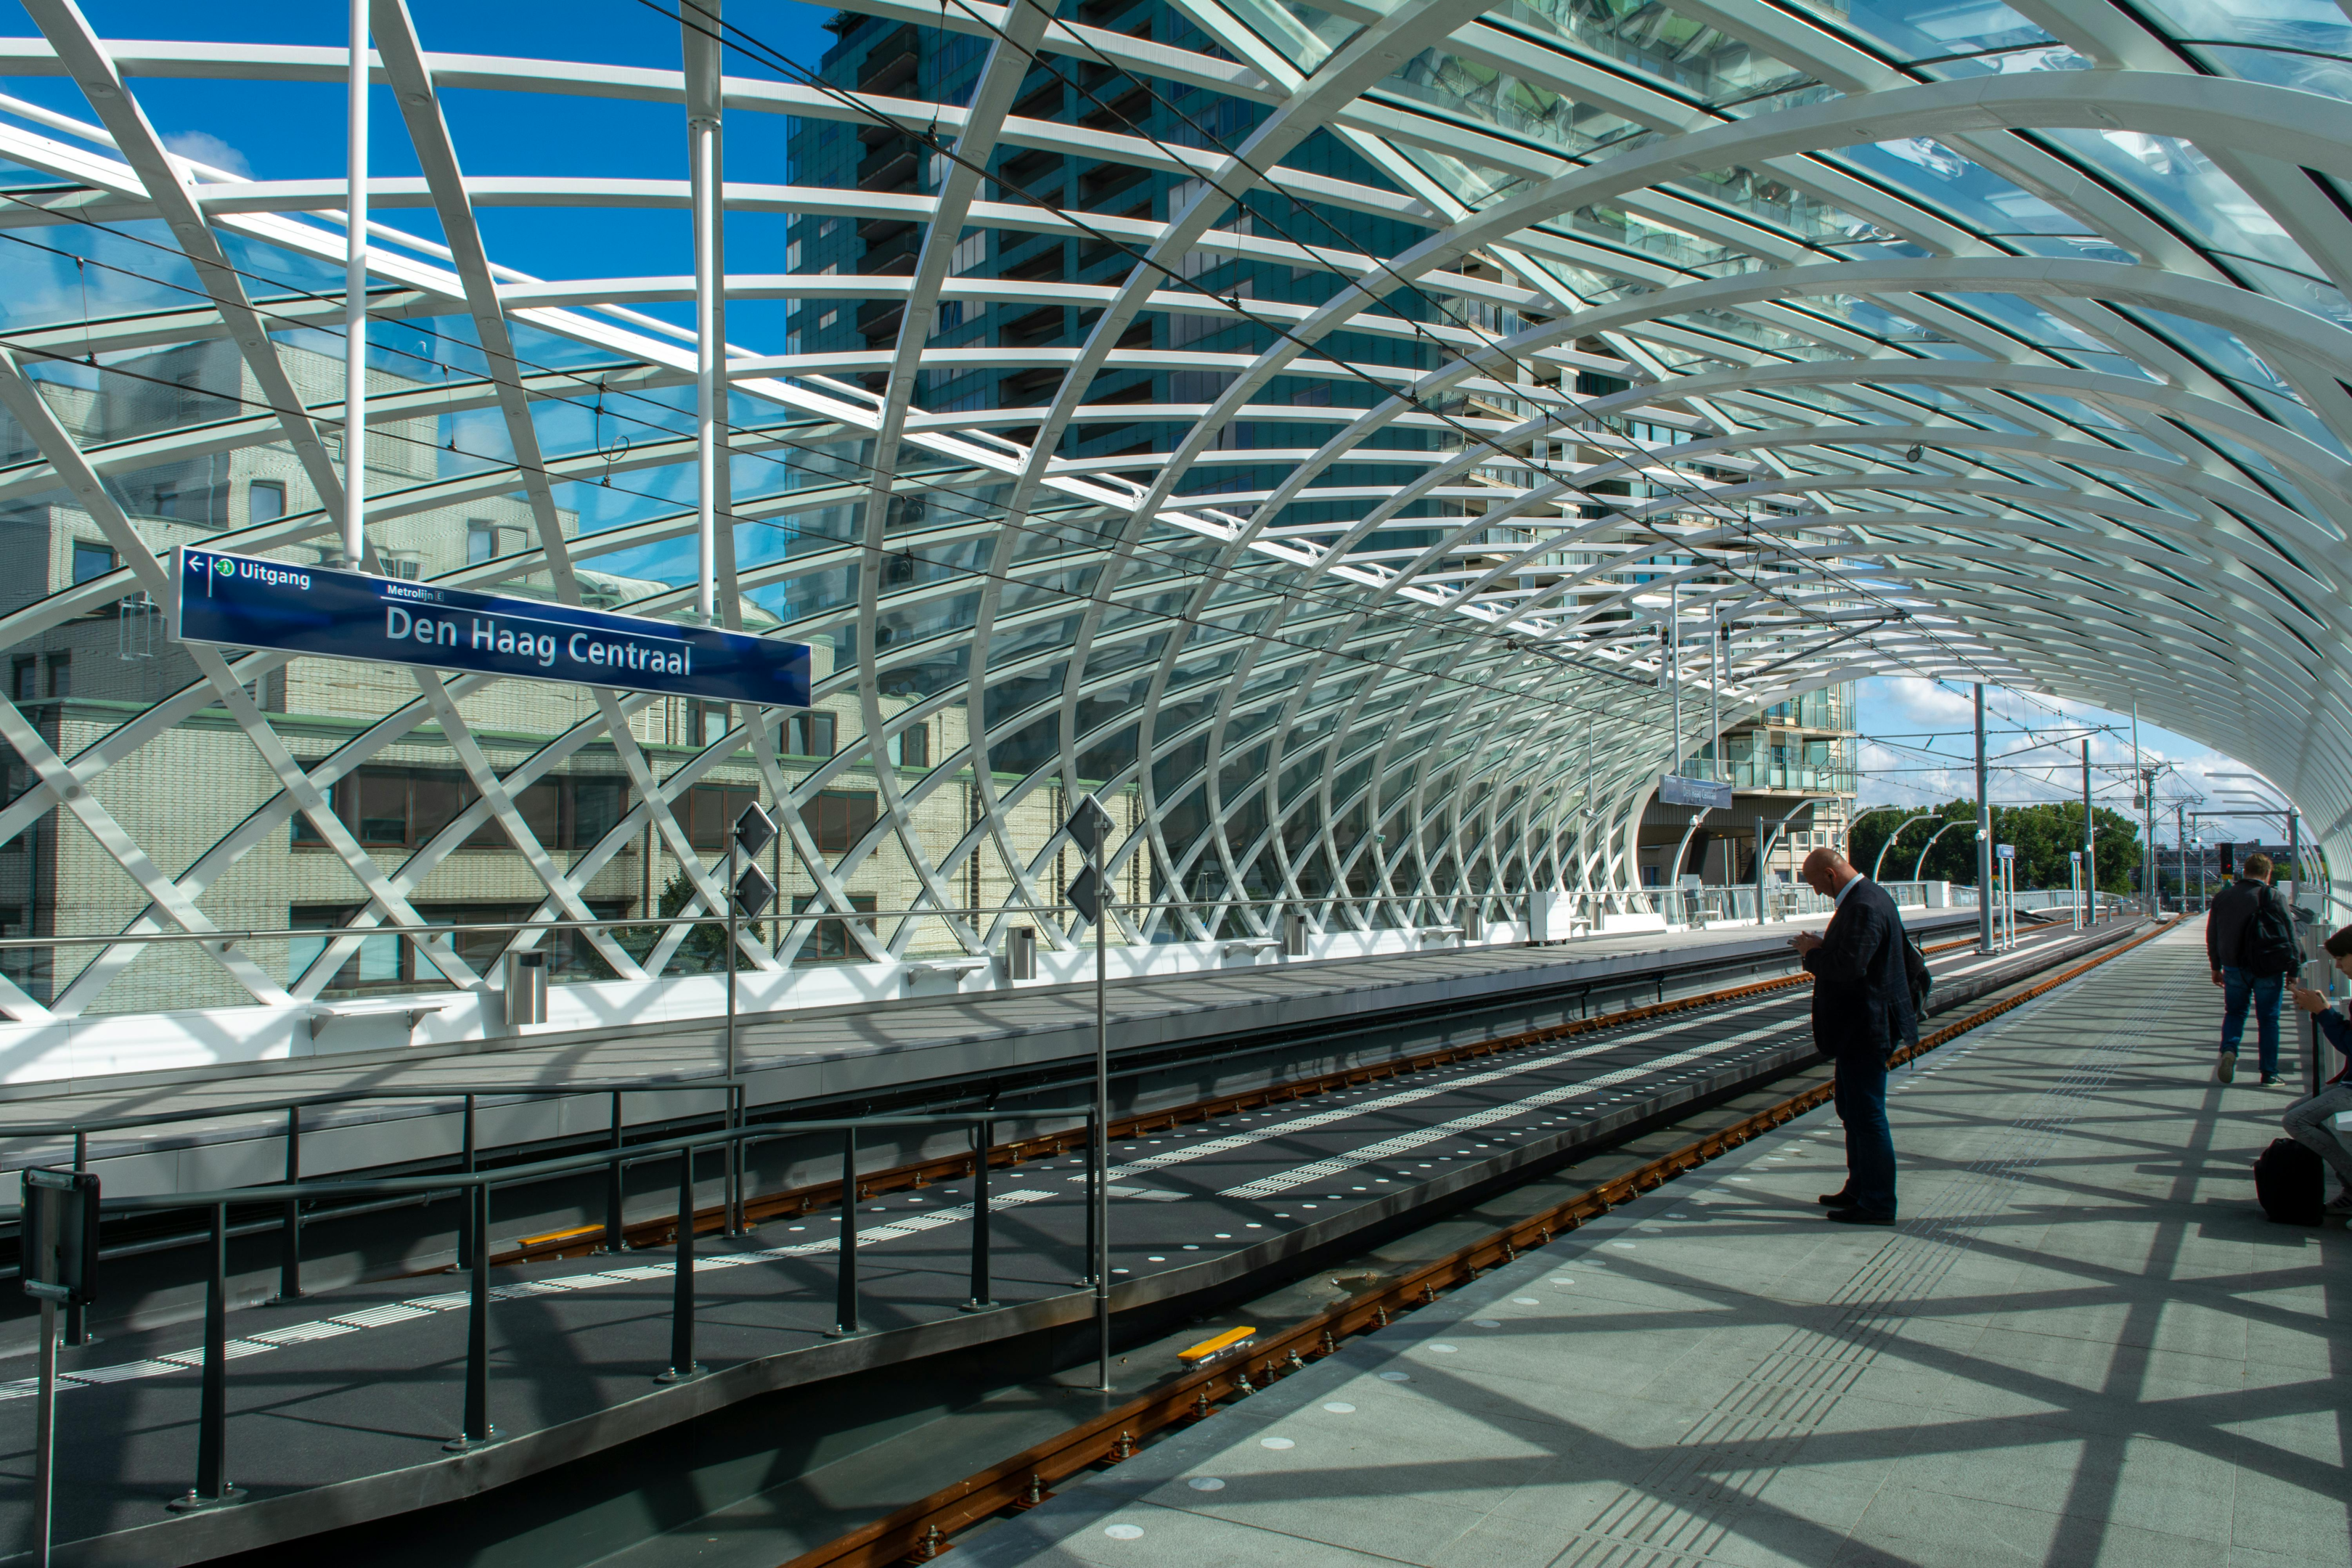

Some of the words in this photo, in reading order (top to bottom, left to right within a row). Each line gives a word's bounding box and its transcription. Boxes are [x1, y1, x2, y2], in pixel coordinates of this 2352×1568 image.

[240, 562, 311, 590] Uitgang
[387, 584, 434, 601] Metrolijn
[386, 606, 457, 647] Den
[471, 618, 556, 667] Haag
[568, 632, 691, 675] Centraal
